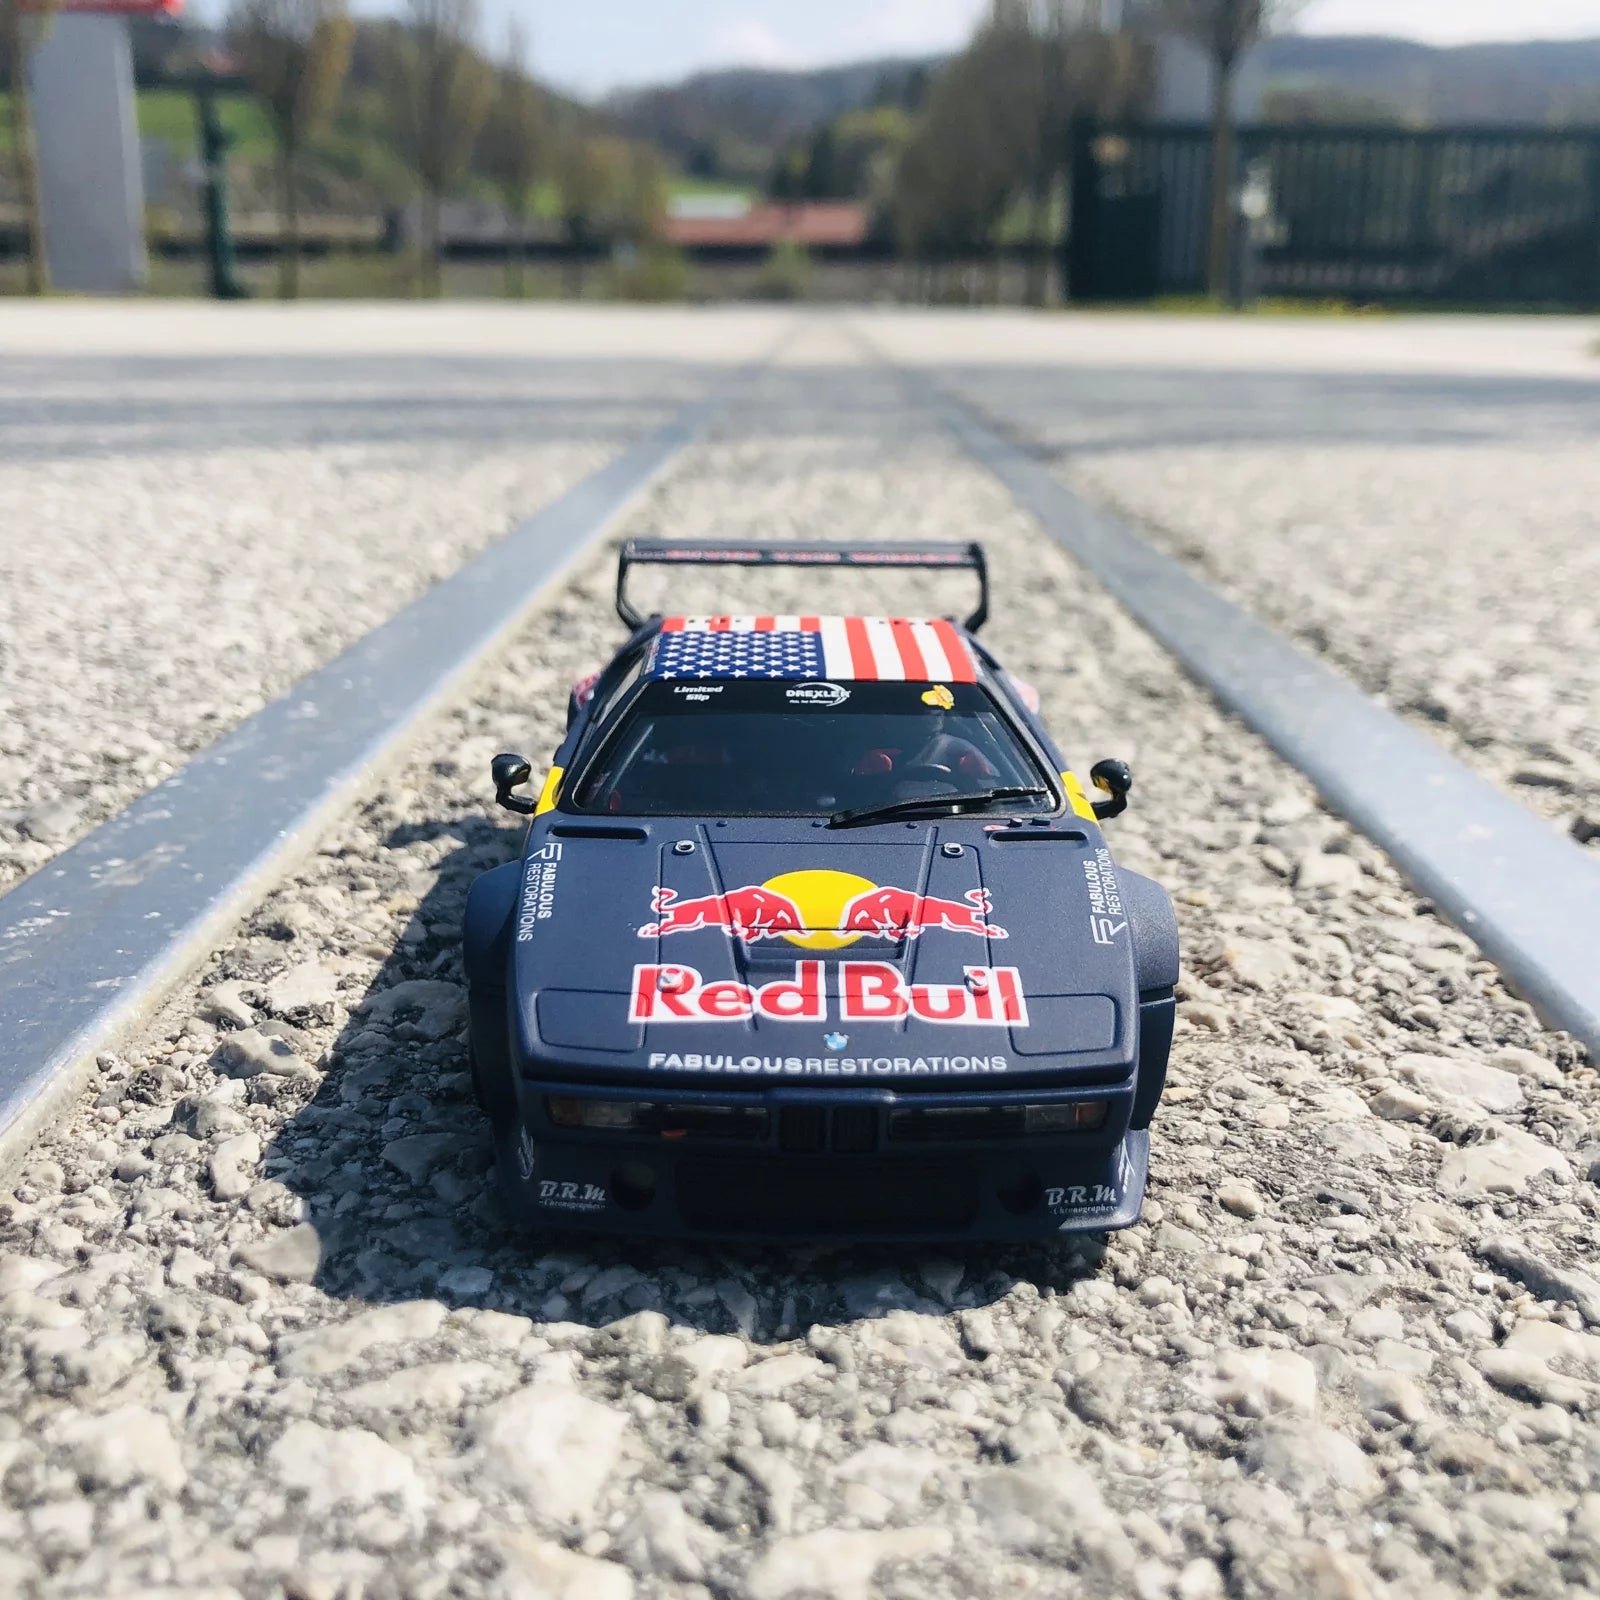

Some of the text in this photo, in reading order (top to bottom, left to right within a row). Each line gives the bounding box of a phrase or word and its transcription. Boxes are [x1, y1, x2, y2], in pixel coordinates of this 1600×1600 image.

[674, 686, 724, 694] Limited
[685, 693, 710, 702] Slip
[785, 689, 850, 699] DREXLER
[517, 862, 542, 942] RESTORATIONS
[537, 862, 557, 920] FABULOUS
[1082, 860, 1107, 915] FABULOUS
[1094, 847, 1123, 916] RESTORATIONS
[627, 960, 1031, 1028] Red Bull
